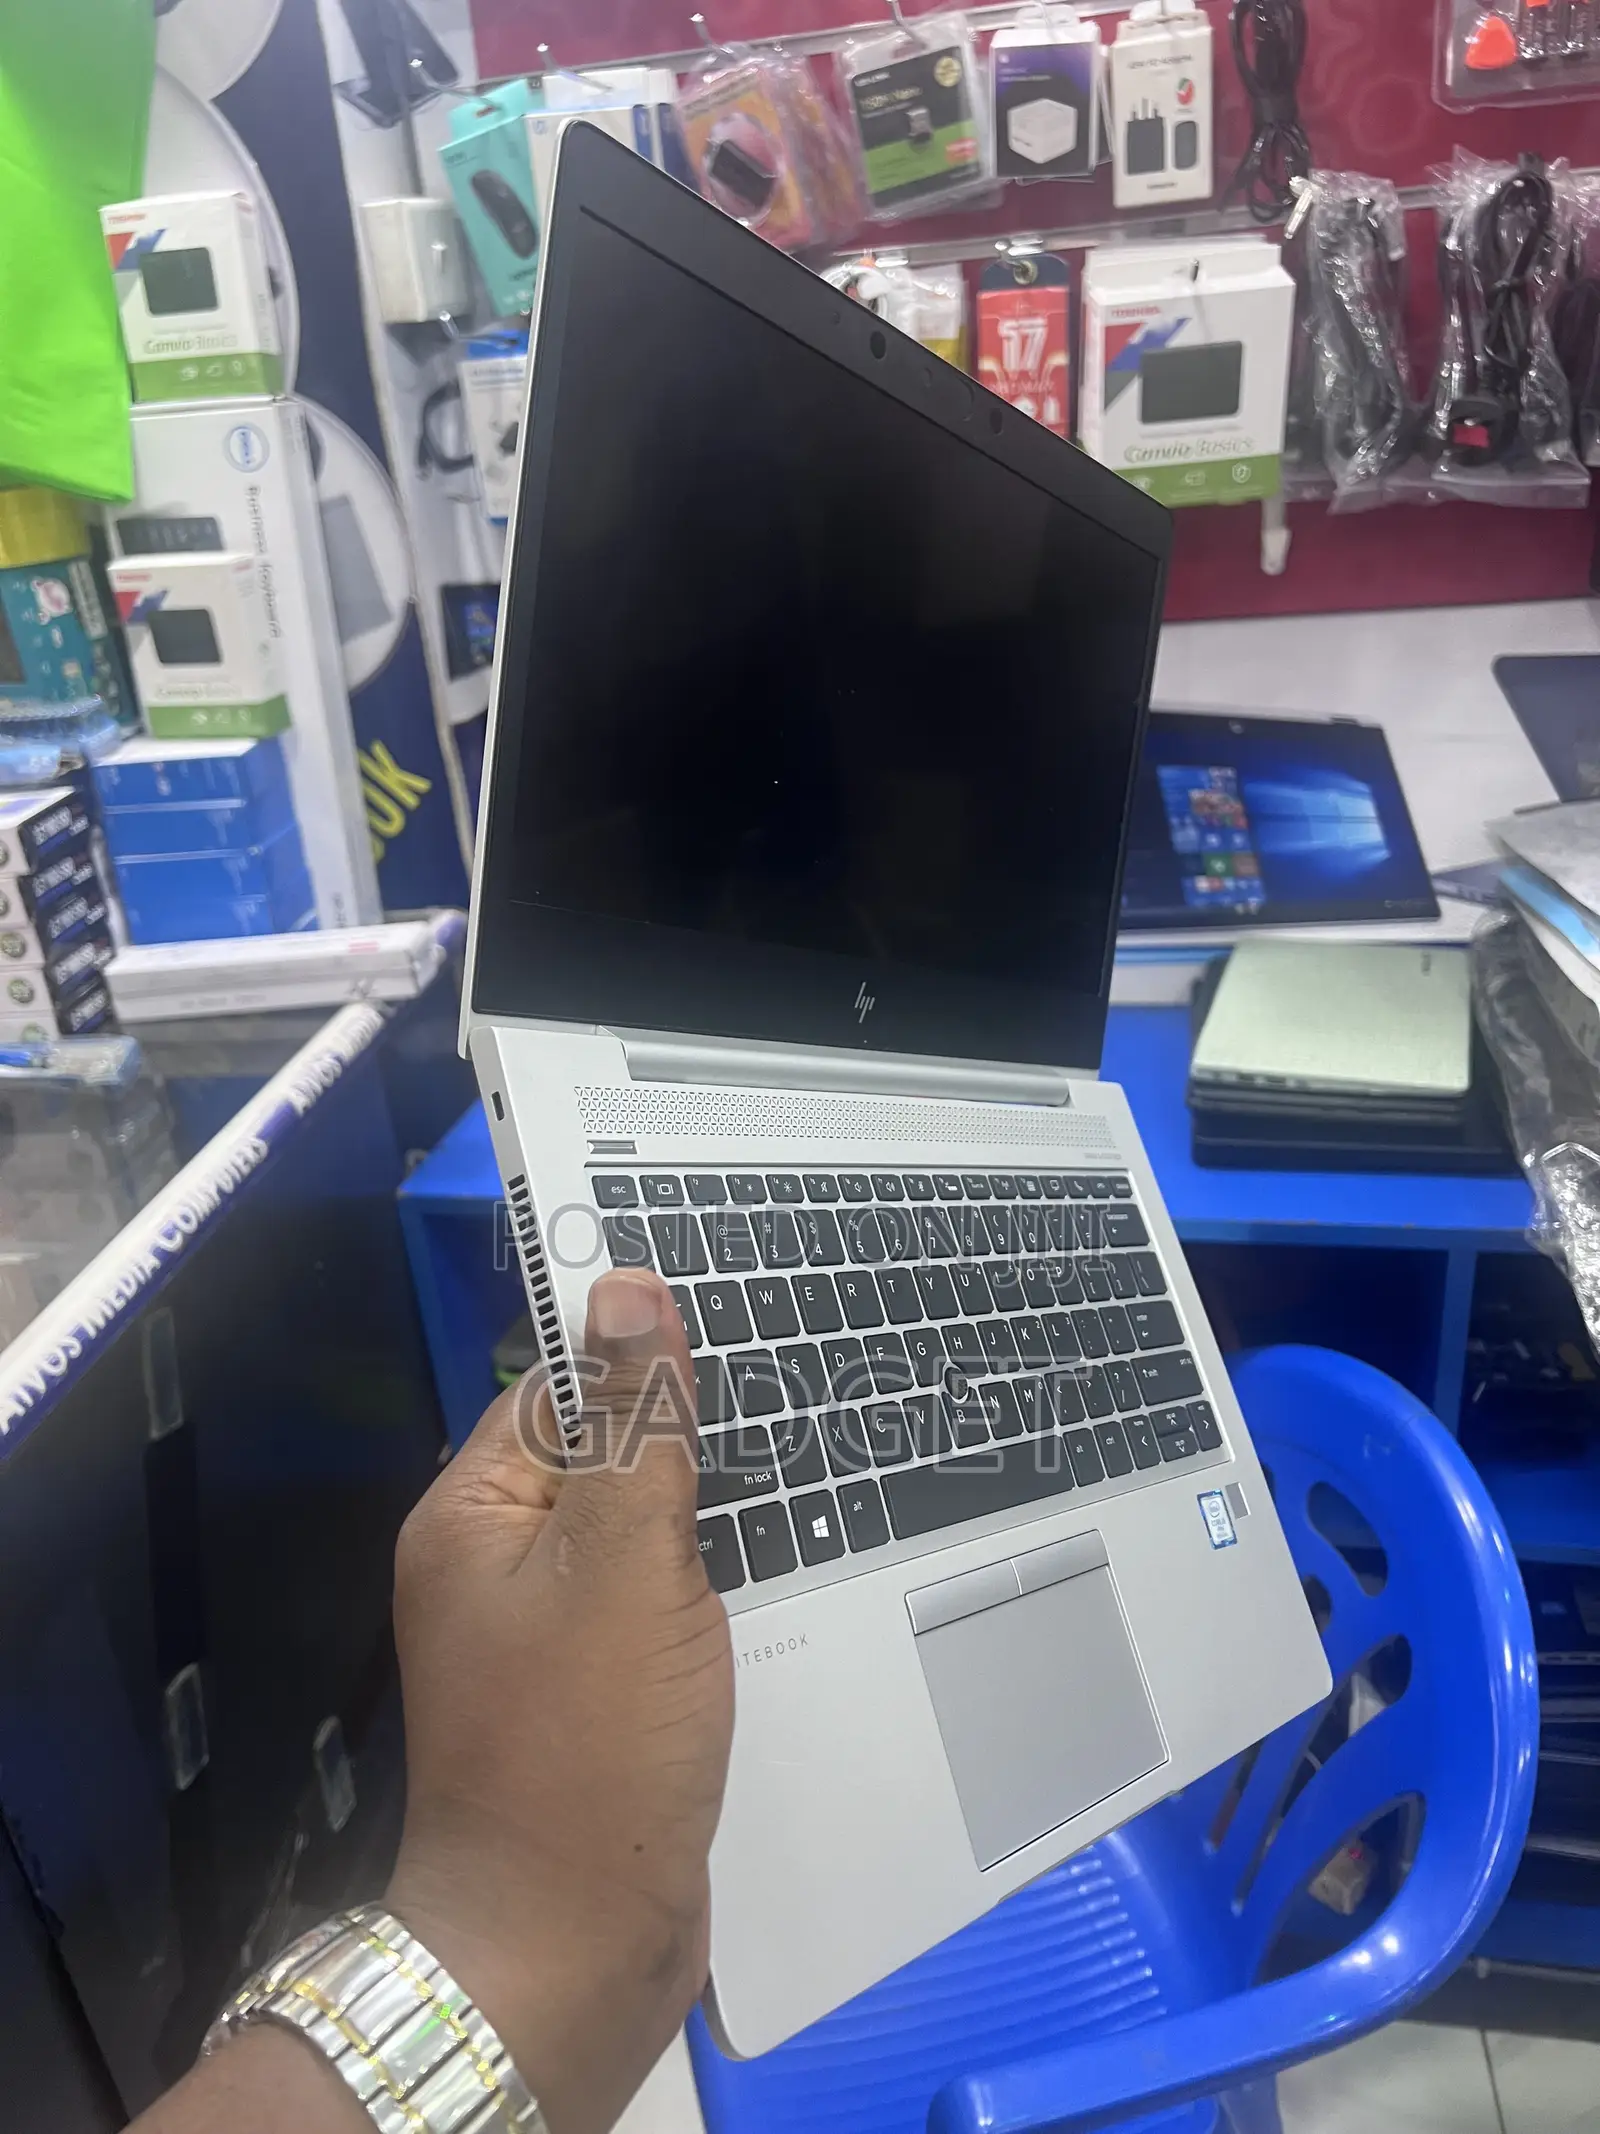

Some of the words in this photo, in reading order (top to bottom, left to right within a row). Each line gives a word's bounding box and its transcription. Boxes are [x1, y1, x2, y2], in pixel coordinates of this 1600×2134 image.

[611, 1185, 627, 1194] esc
[716, 1224, 729, 1240] @
[670, 1251, 678, 1264] 1
[724, 1247, 733, 1261] 2
[770, 1245, 779, 1259] 3
[815, 1243, 823, 1256] 4
[856, 1241, 864, 1253] 5
[895, 1239, 903, 1250] 6
[930, 1237, 936, 1249] 7
[965, 1235, 973, 1247] 8
[997, 1233, 1005, 1245] 9
[710, 1295, 723, 1310] Q
[759, 1290, 774, 1305] W
[804, 1286, 815, 1301] E
[846, 1283, 857, 1297] R
[887, 1279, 896, 1294] T
[925, 1277, 934, 1290] Y
[960, 1274, 970, 1287] U
[1026, 1268, 1035, 1281] O
[1055, 1266, 1062, 1278] P
[745, 1365, 756, 1381] A
[790, 1358, 800, 1374] S
[835, 1352, 845, 1368] D
[876, 1346, 885, 1361] F
[916, 1342, 927, 1356] G
[953, 1337, 963, 1350] H
[990, 1332, 996, 1346] J
[1021, 1328, 1031, 1341] K
[1052, 1324, 1060, 1336] L
[786, 1435, 797, 1452] Z
[831, 1426, 843, 1443] X
[876, 1418, 886, 1433] C
[915, 1410, 925, 1424] V
[956, 1409, 966, 1423] B
[989, 1395, 1000, 1409] N
[1023, 1389, 1034, 1402] M
[744, 1475, 754, 1486] fn
[754, 1471, 772, 1483] lock
[853, 1501, 863, 1512] alt
[756, 1525, 766, 1537] fn
[698, 1538, 713, 1552] ctrl
